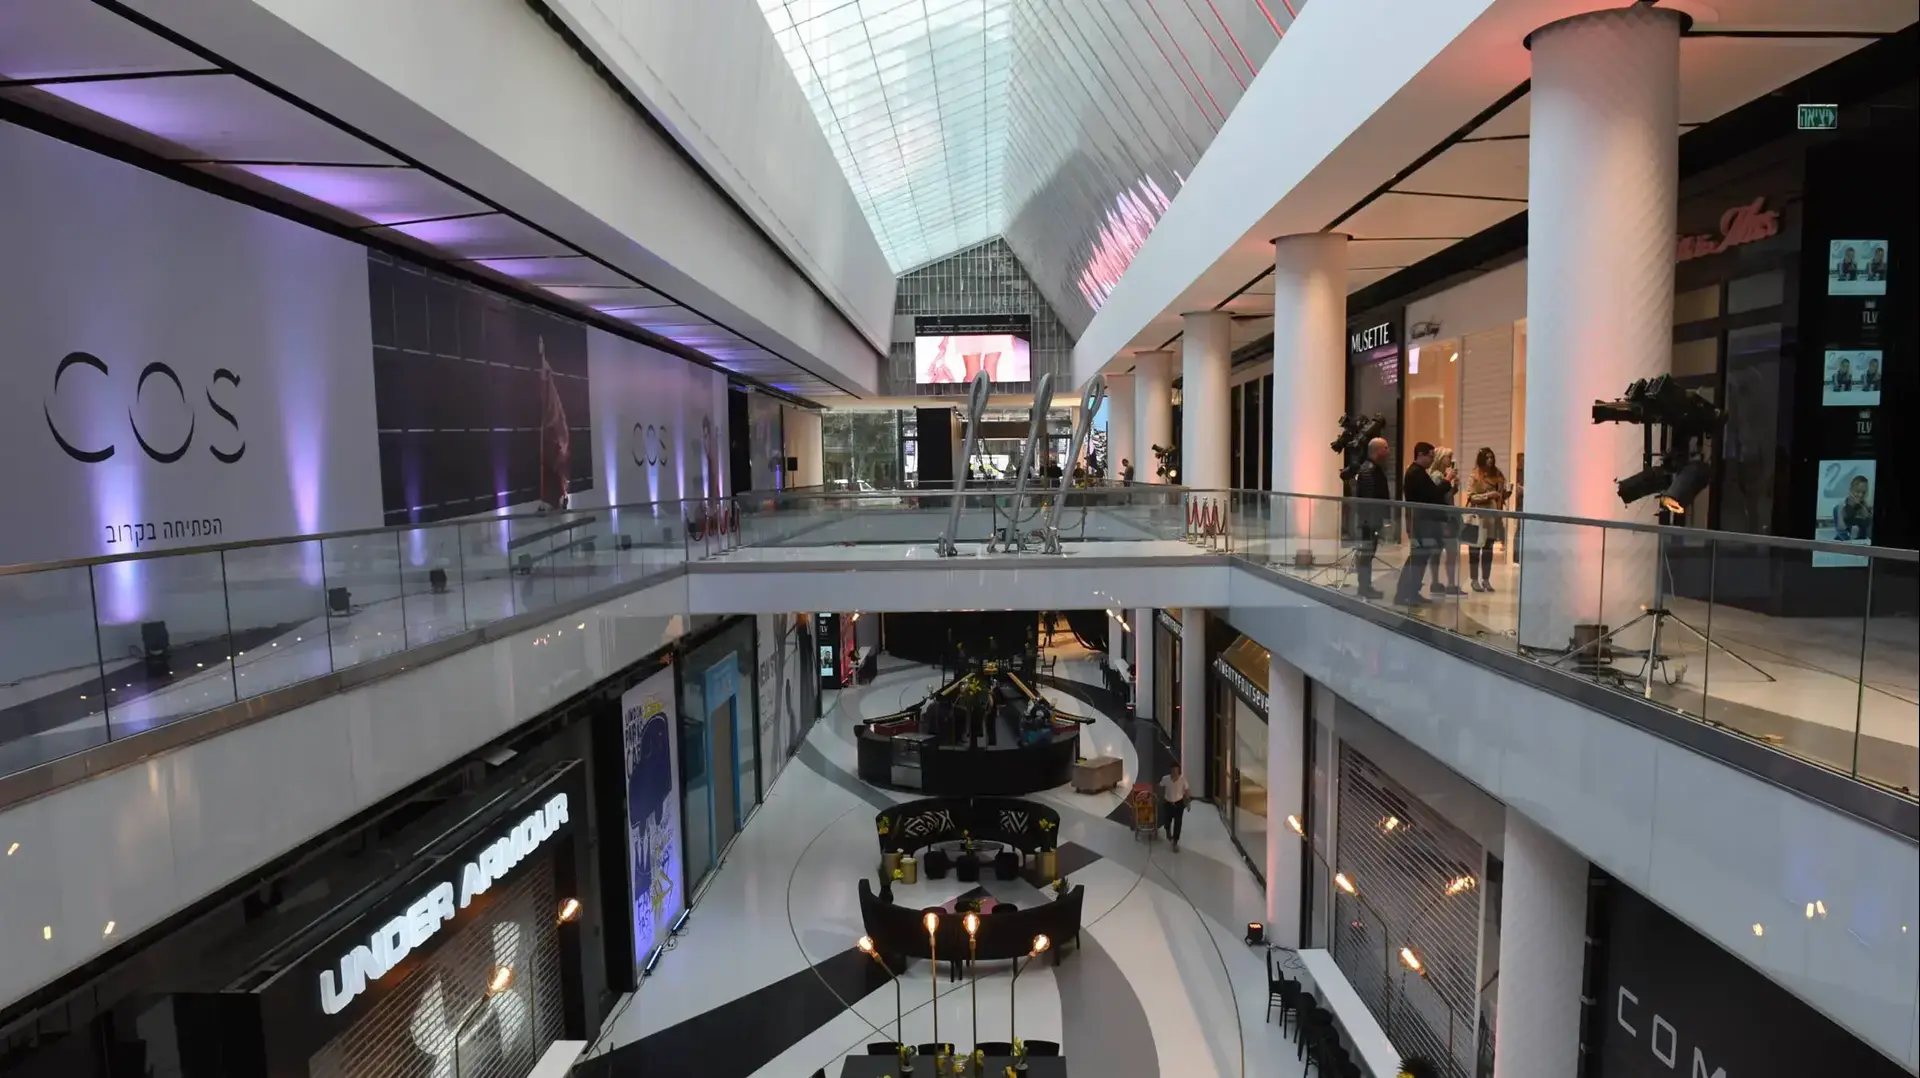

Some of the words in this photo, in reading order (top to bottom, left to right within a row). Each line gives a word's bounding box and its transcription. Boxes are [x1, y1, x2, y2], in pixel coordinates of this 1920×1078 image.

[1800, 107, 1829, 127] יציאה
[1861, 309, 1879, 325] TLV
[1351, 321, 1390, 354] MUSETTE
[42, 351, 247, 465] COS
[1855, 420, 1873, 434] TLV
[632, 422, 668, 467] COS
[105, 521, 157, 549] בקרוב
[162, 516, 224, 540] הפתיחה
[319, 881, 456, 1016] UNDER
[460, 792, 570, 909] ARMOUR
